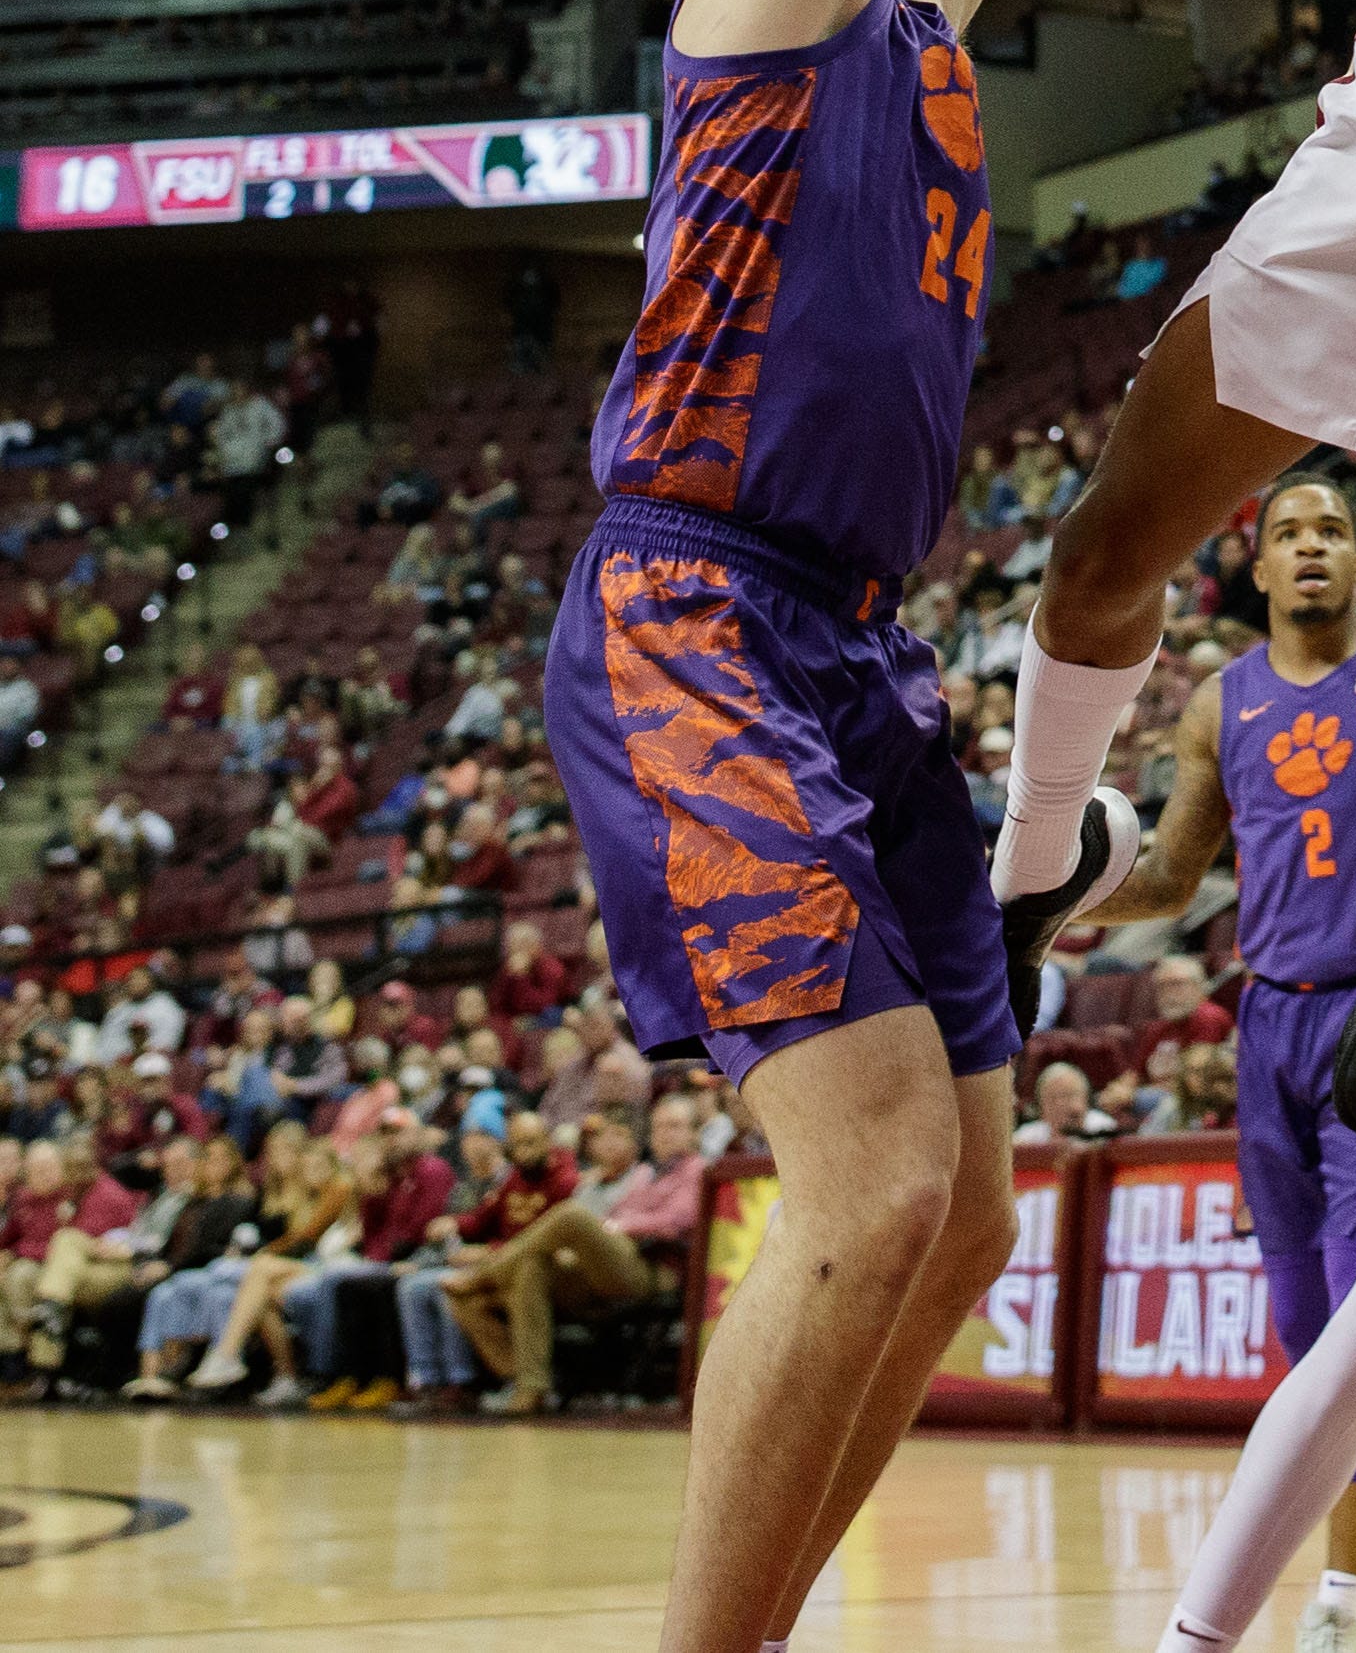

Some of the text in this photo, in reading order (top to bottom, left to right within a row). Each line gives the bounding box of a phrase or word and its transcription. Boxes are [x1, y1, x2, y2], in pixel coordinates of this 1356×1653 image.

[152, 157, 234, 201] FSU
[264, 175, 374, 219] 2 4
[919, 186, 991, 321] 24
[1301, 808, 1338, 879] 2
